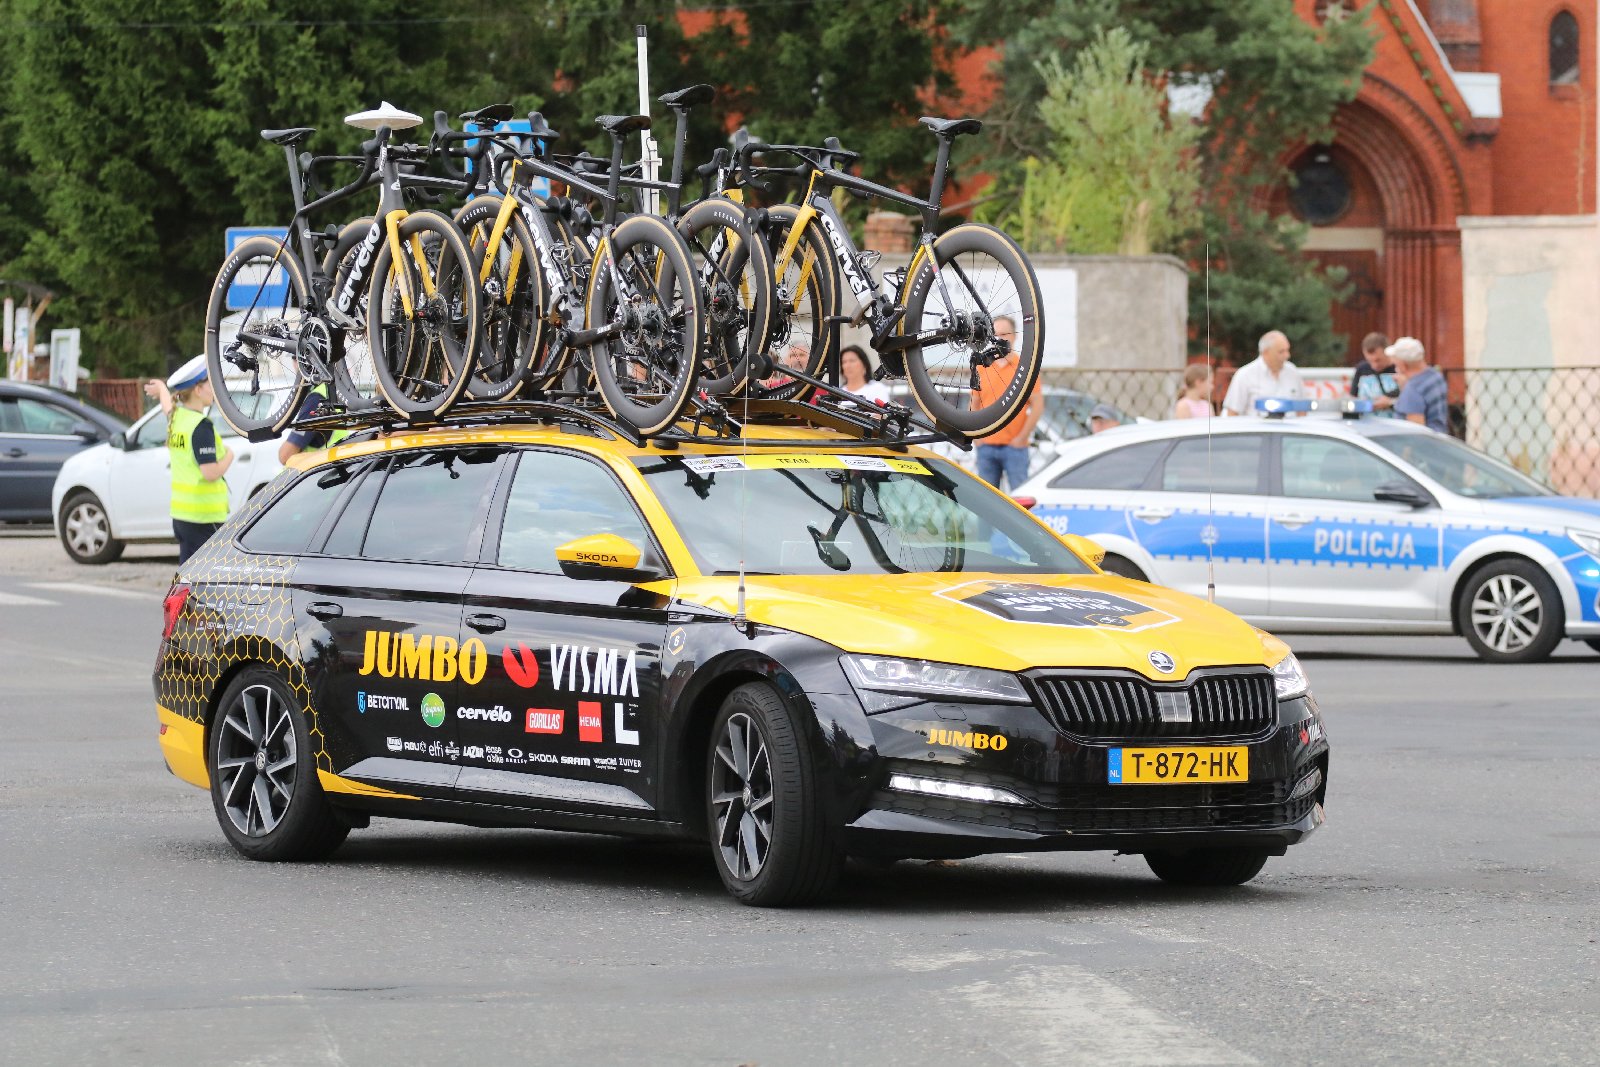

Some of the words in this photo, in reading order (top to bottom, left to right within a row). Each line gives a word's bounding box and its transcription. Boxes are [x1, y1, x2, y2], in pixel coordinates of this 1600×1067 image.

[1313, 528, 1417, 560] POLICJA
[359, 631, 487, 685] JUMBO
[550, 643, 640, 698] VISMA
[457, 705, 512, 723] cervélo
[529, 712, 560, 730] GORILLAS
[579, 716, 601, 728] HEMA
[926, 729, 1008, 751] JUMBO
[560, 756, 591, 767] SRAM
[618, 757, 643, 768] ZUIVER
[1131, 751, 1240, 778] T-872-HK
[1109, 769, 1121, 778] NL
